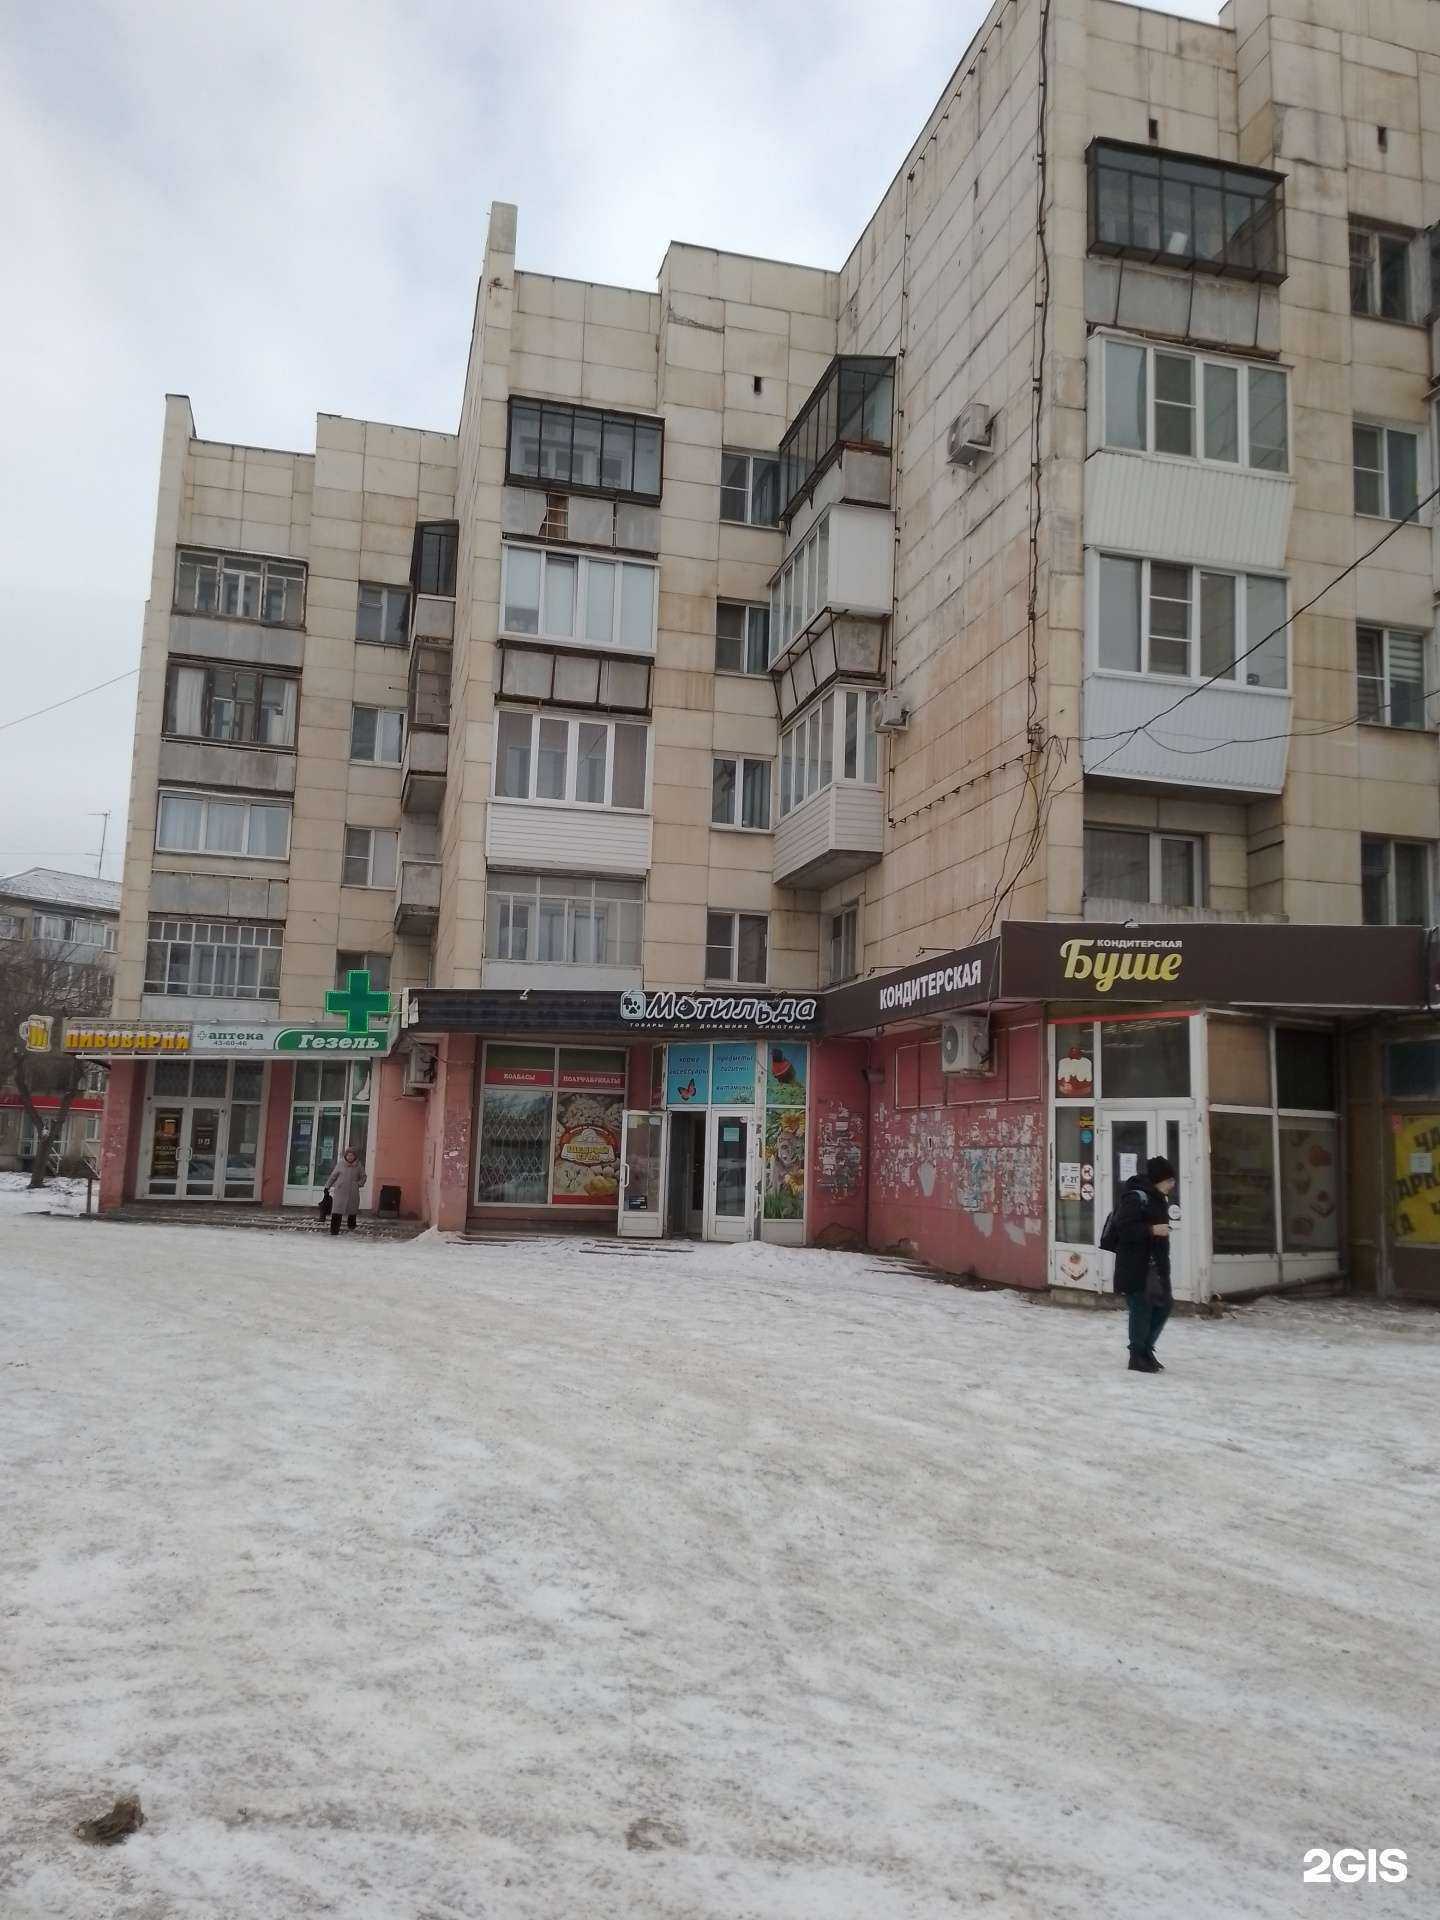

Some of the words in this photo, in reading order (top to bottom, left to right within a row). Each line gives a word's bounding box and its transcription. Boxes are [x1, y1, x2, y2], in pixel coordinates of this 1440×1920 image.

[1097, 939, 1183, 949] КОНДИТЕРСКАЯ
[1060, 939, 1183, 992] Буше
[879, 959, 982, 1010] КОНДИТЕРСКАЯ
[645, 992, 817, 1025] Мотильда
[208, 1032, 264, 1041] аптека
[298, 1034, 380, 1049] Гезель
